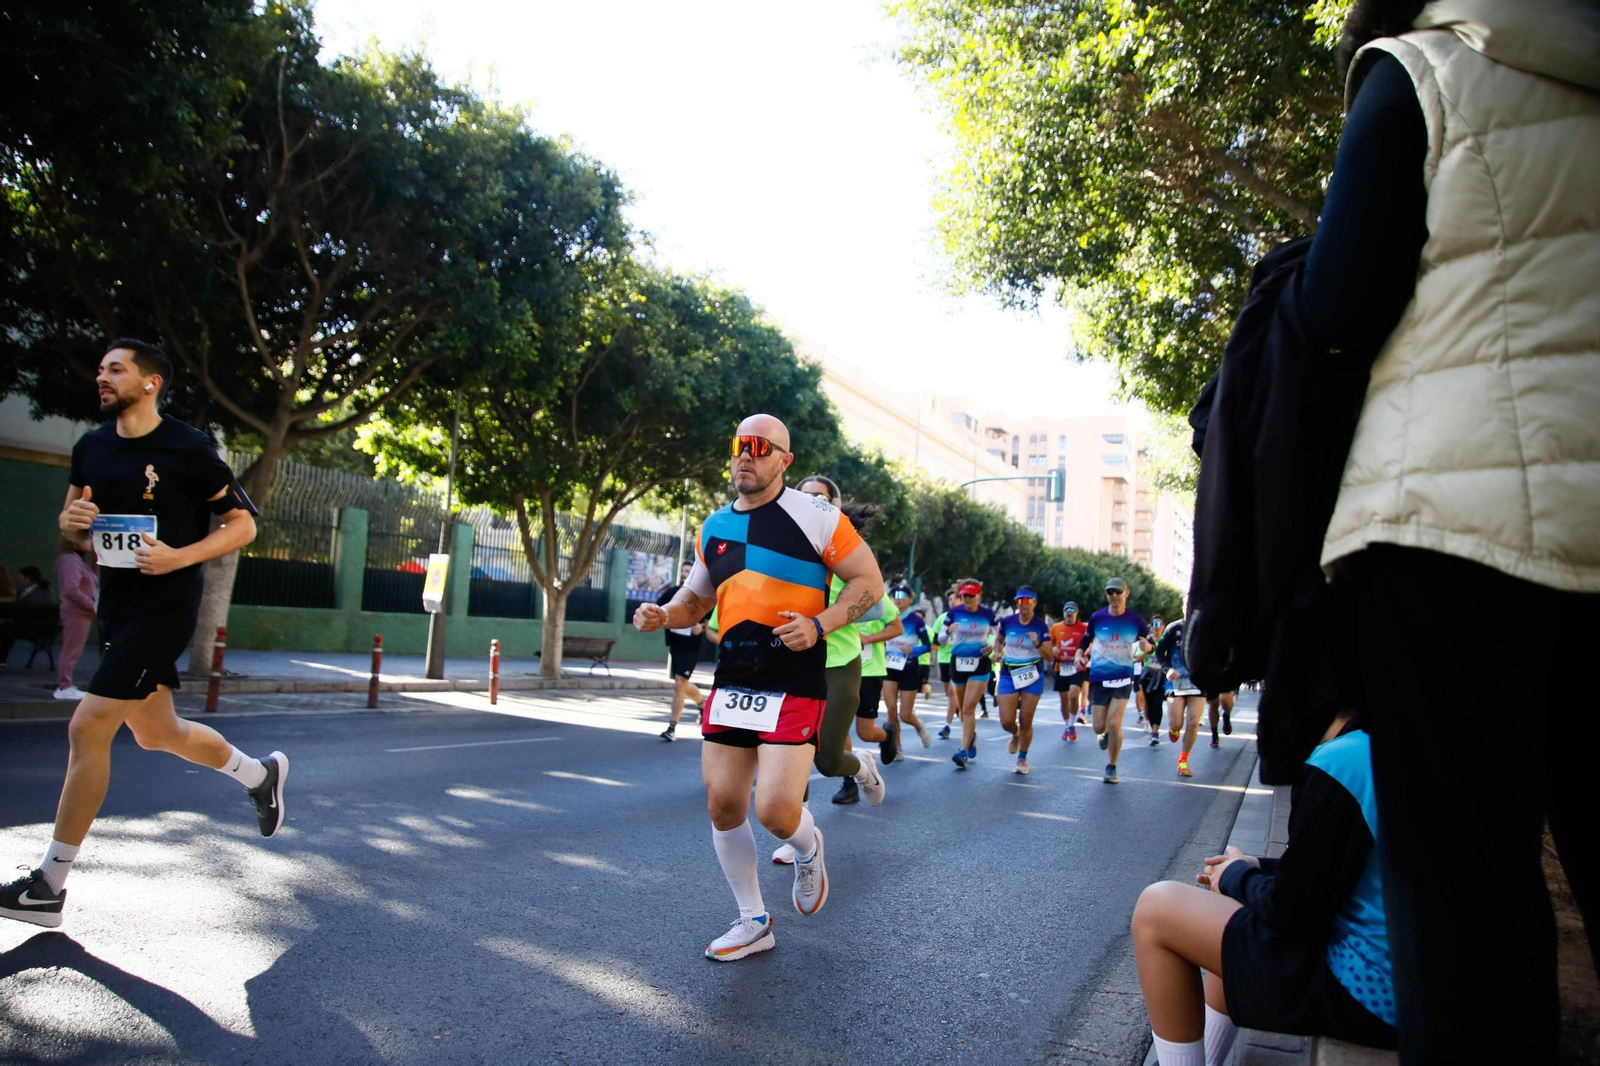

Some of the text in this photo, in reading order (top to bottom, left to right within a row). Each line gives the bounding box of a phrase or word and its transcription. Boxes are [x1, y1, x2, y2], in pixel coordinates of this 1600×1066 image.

[102, 532, 141, 551] 818
[960, 658, 975, 666] 792
[1018, 671, 1034, 681] 128
[724, 692, 768, 713] 309
